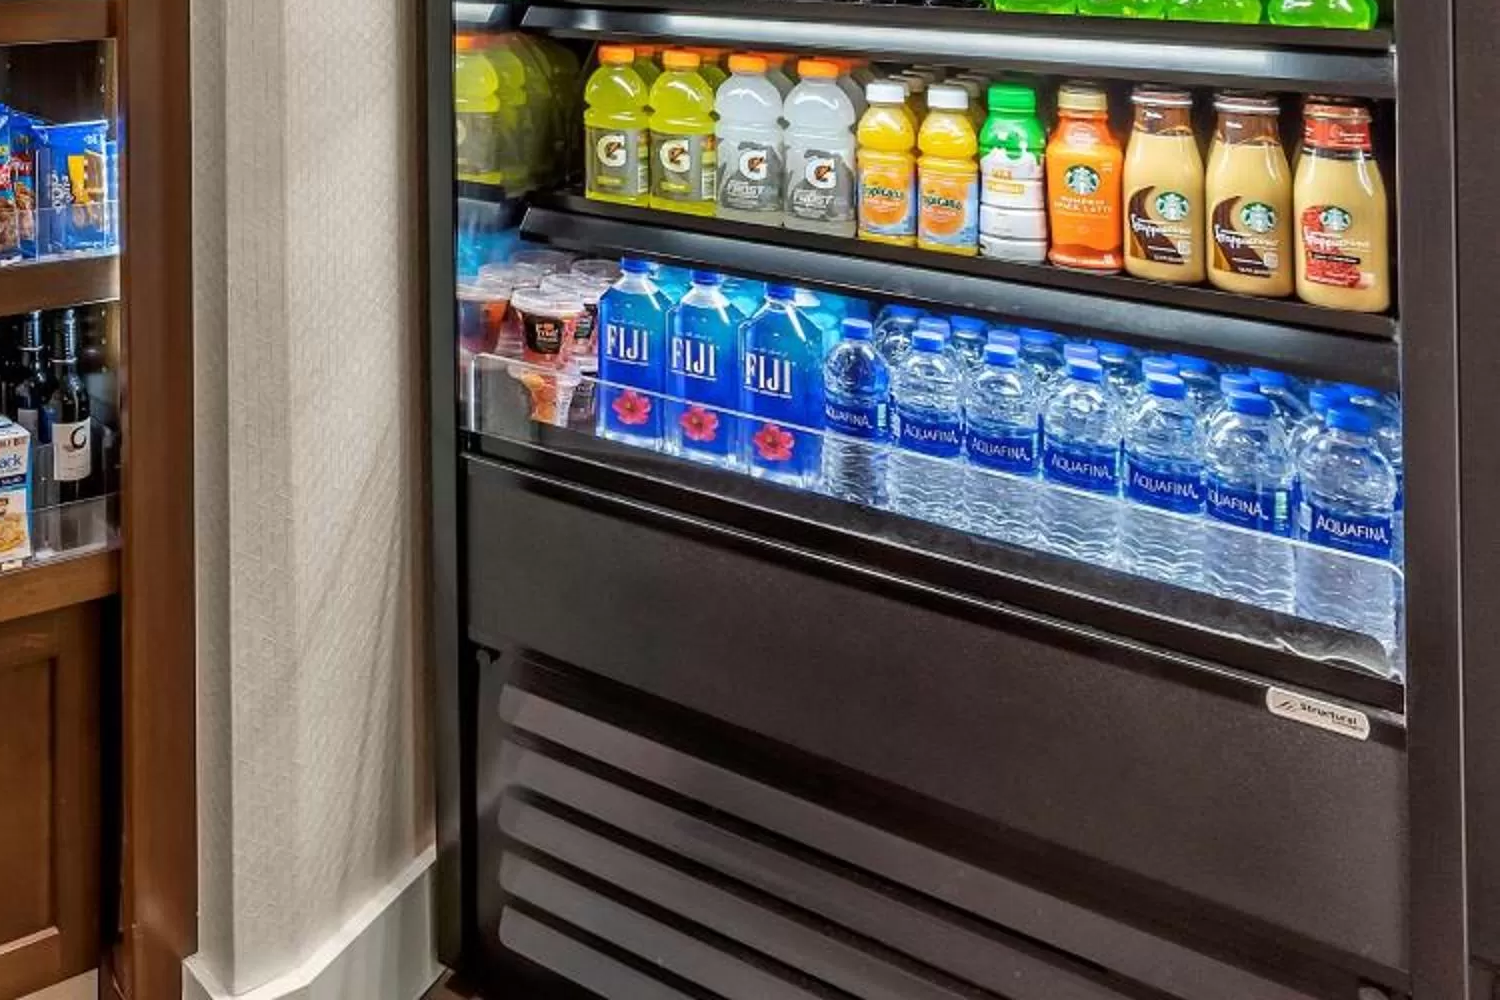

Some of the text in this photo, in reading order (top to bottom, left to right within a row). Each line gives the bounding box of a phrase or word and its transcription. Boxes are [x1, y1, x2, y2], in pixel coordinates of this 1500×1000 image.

[597, 135, 627, 167] G
[660, 139, 692, 173] G
[739, 150, 767, 180] G
[805, 156, 837, 189] G
[606, 323, 648, 361] FIJI
[671, 336, 716, 378] FIJI
[745, 351, 792, 394] FIJI
[825, 403, 873, 430] AQUAFINA
[903, 423, 959, 445] AQUAFINA
[970, 436, 1031, 461] AQUAFINA
[1051, 453, 1113, 480] AQUAFINA
[1133, 471, 1199, 500] AQUAFINA
[1315, 514, 1389, 545] AQUAFINA
[1300, 703, 1357, 725] Structural
